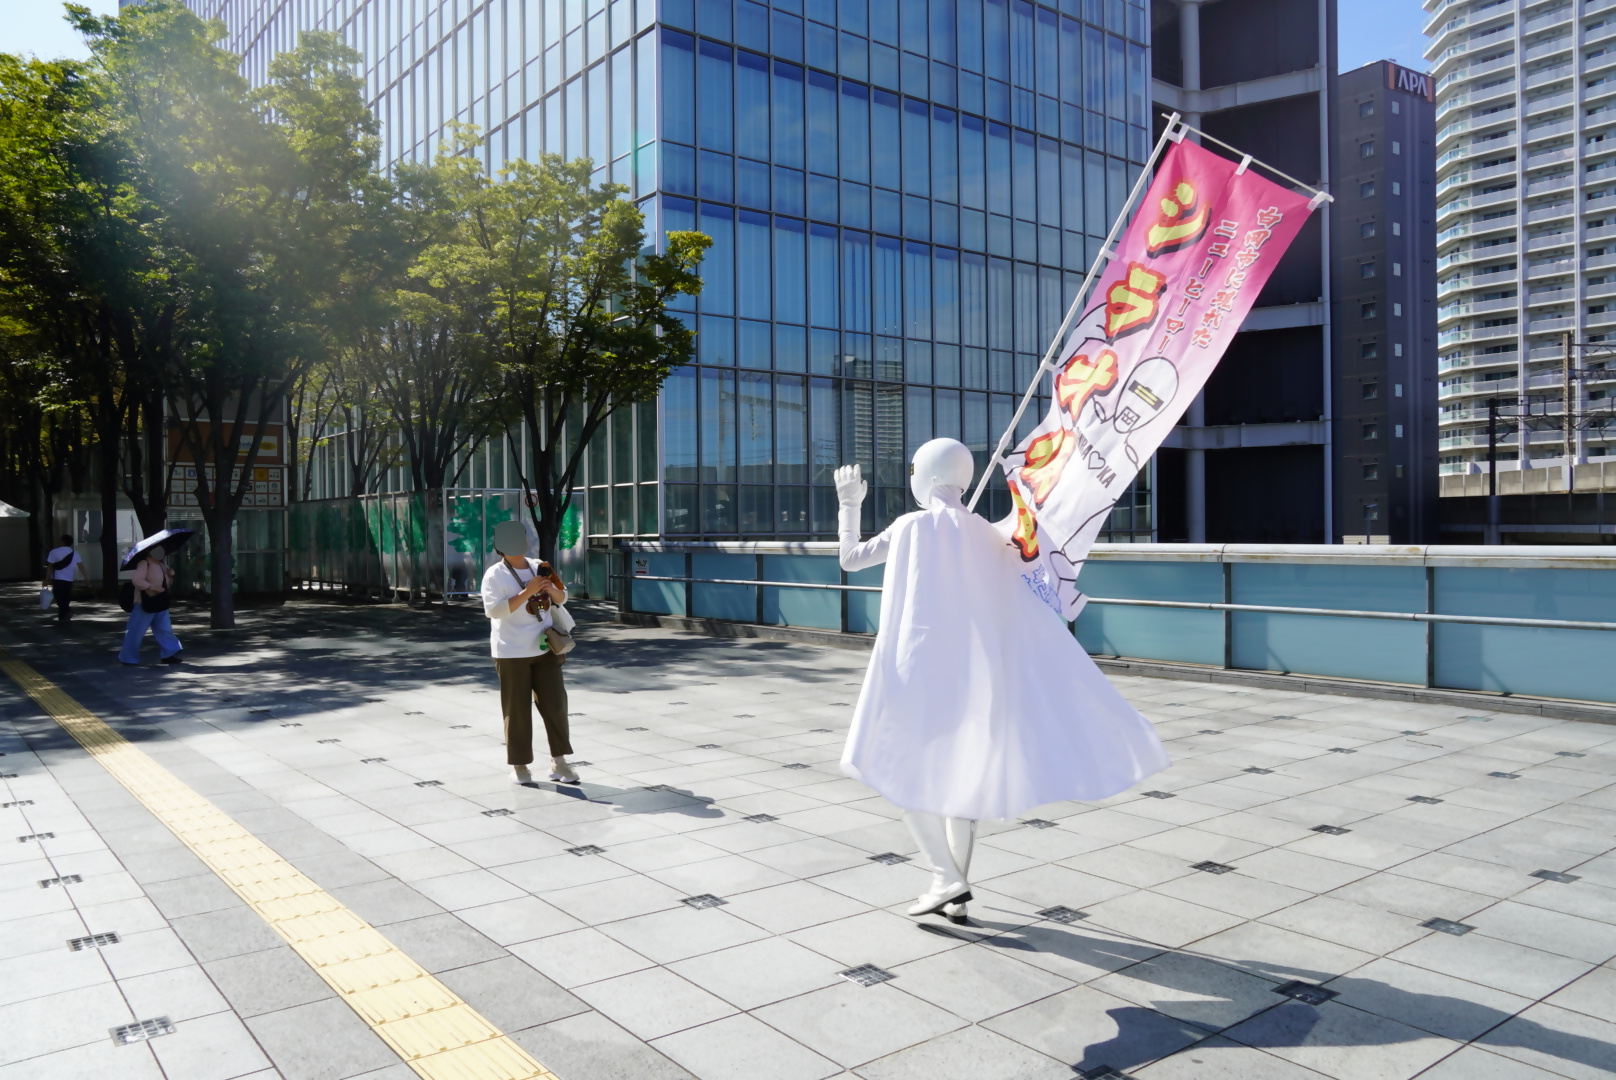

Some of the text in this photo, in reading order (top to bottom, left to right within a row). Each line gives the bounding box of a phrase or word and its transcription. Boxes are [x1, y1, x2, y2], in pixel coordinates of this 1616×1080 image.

[1398, 69, 1428, 97] APA
[1157, 219, 1239, 354] ニューヒーロー
[1191, 206, 1283, 348] 白岡市に現れた
